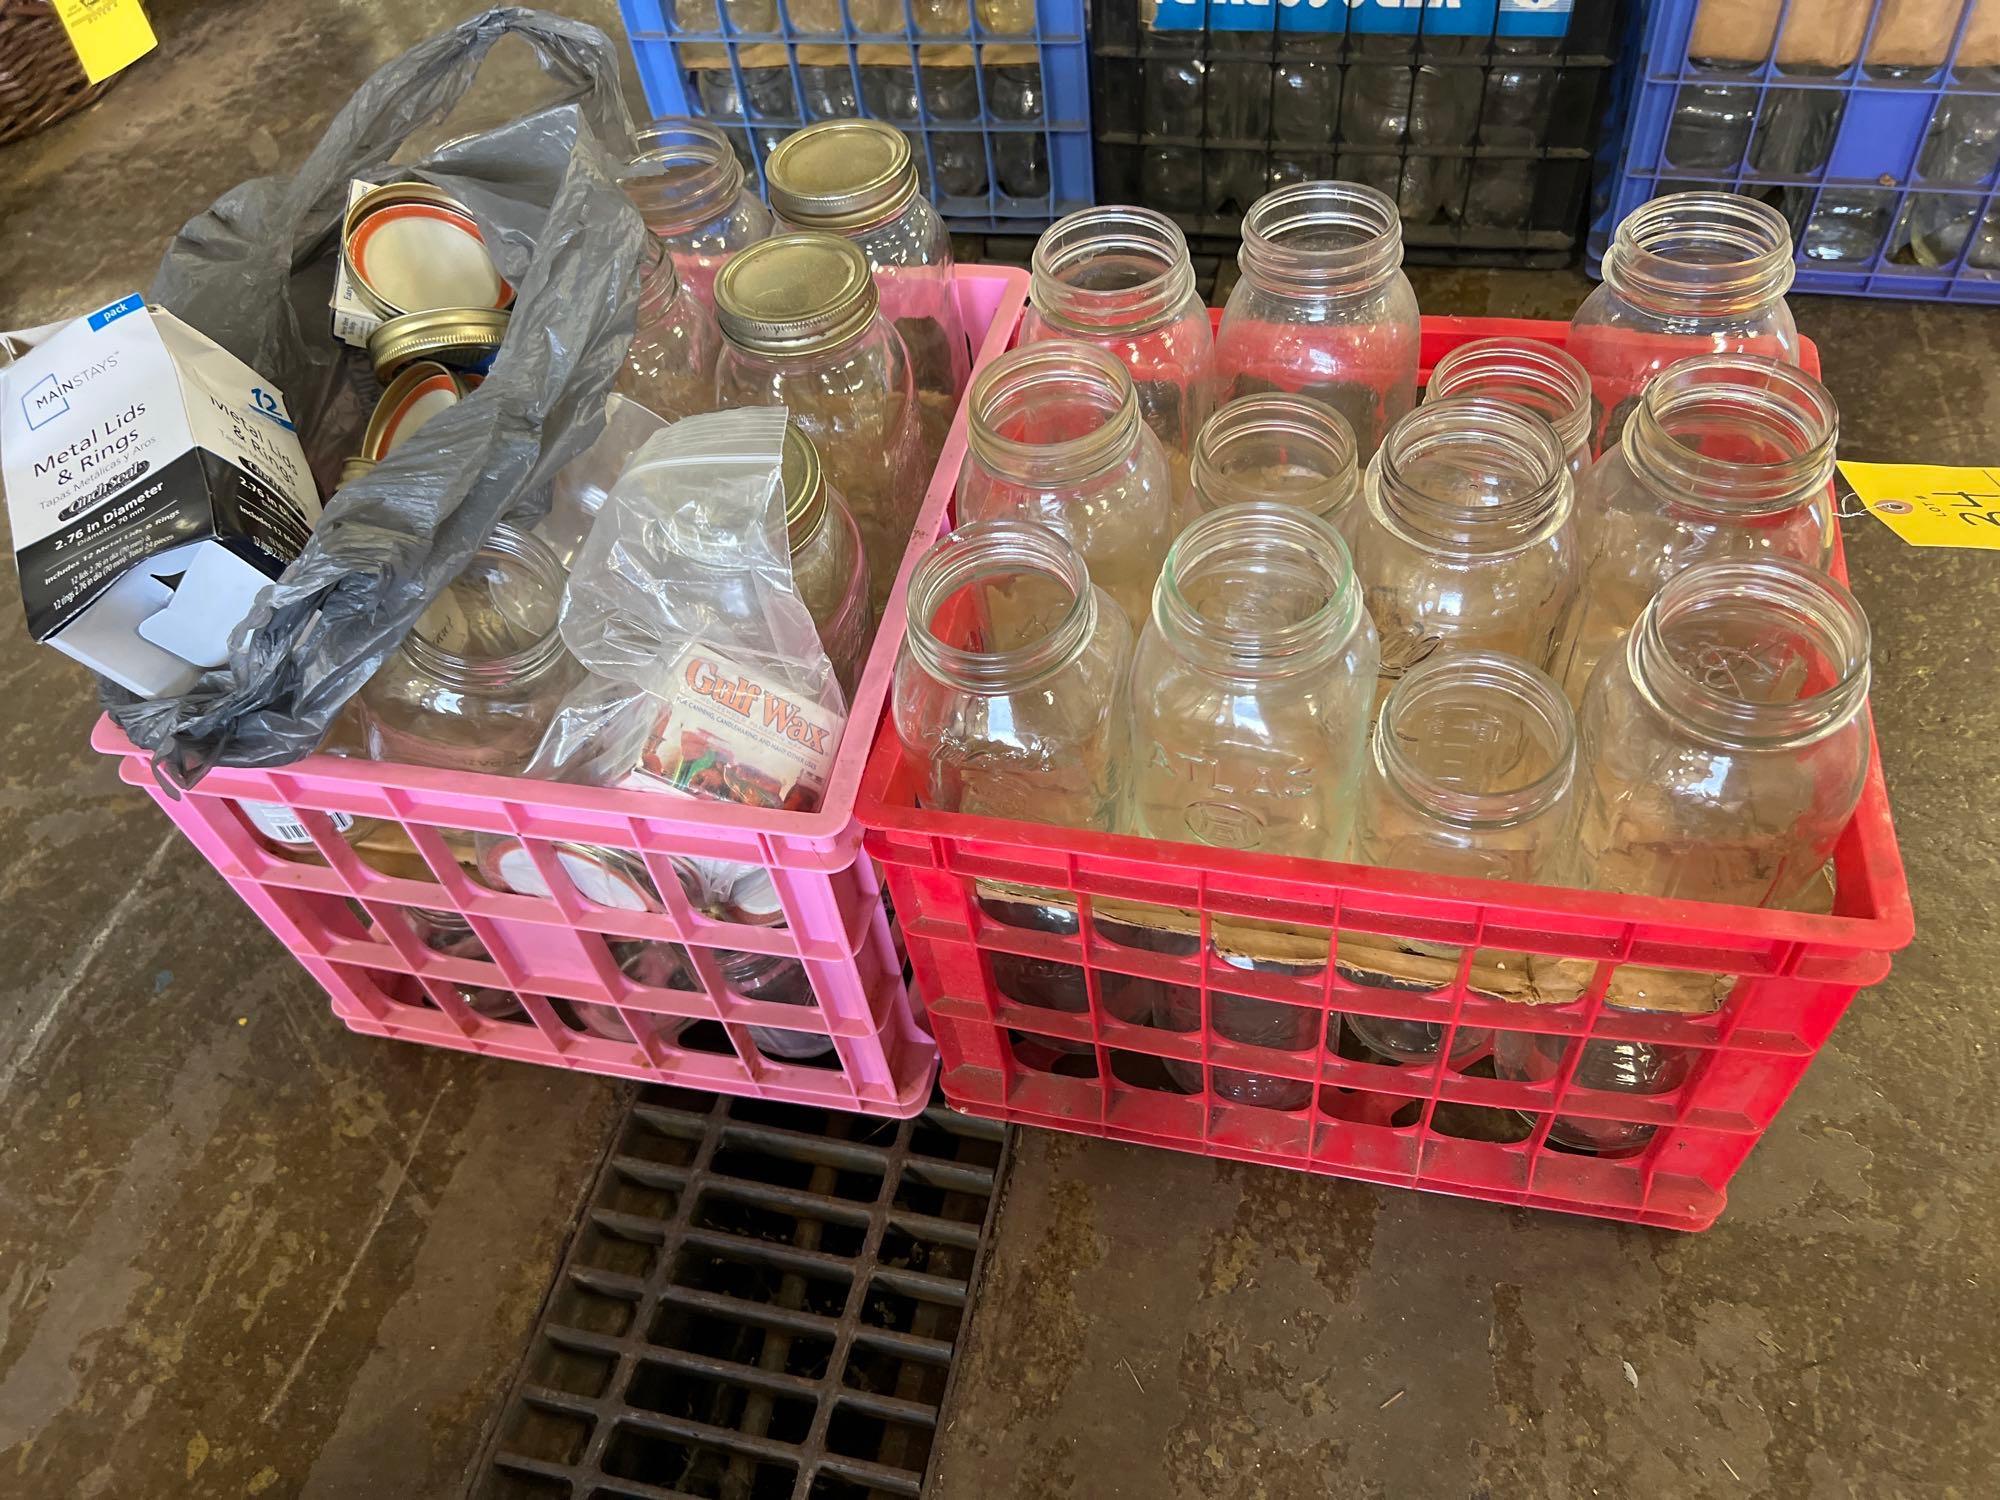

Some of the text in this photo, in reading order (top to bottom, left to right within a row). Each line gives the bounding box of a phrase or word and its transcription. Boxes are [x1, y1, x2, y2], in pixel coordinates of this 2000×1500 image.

[103, 302, 129, 322] pack
[36, 354, 119, 410] MAINSTAYS
[250, 387, 283, 417] 12
[33, 402, 147, 478] Metal Lids
[57, 428, 140, 486] & Rings
[209, 393, 264, 443] Metal
[267, 440, 300, 477] Lids
[232, 425, 245, 440] &
[251, 439, 297, 488] Rings
[40, 491, 71, 510] Tapas
[132, 436, 157, 456] Aros
[239, 475, 265, 500] 2.76
[54, 482, 164, 551] 2.76 in Diameter
[118, 516, 128, 525] 70
[129, 506, 146, 519] mm
[239, 504, 273, 531] Includes
[1922, 501, 1948, 517] LOT
[44, 560, 81, 586] Includes
[82, 553, 94, 562] 12
[95, 538, 123, 555] Metal
[124, 528, 143, 541] Lids
[154, 509, 181, 525] Rings
[60, 590, 75, 606] rings
[73, 581, 88, 597] 2.76
[685, 656, 830, 755] Gulf Wax
[716, 717, 758, 742] CANDLEMAKING
[759, 736, 771, 748] AND
[787, 750, 804, 764] OTHER
[1148, 738, 1314, 800] ATLAS
